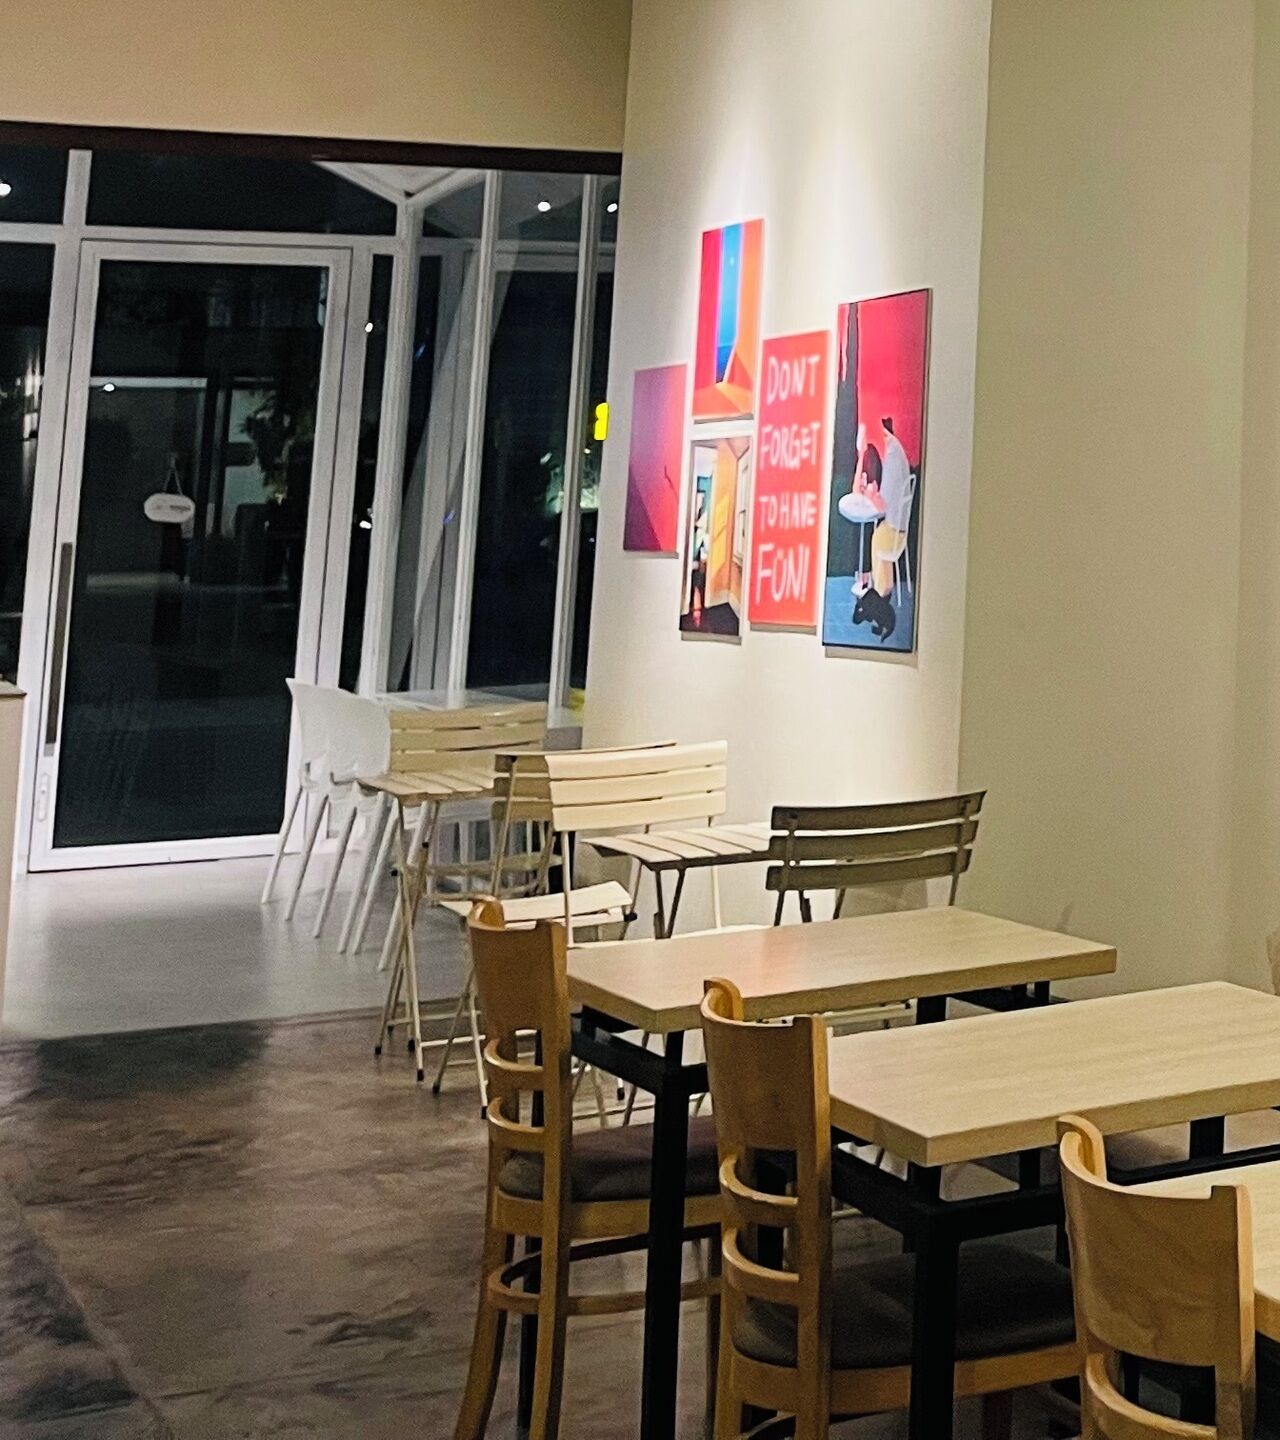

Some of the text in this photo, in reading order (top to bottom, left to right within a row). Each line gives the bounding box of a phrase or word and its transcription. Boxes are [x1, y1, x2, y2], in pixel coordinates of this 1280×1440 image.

[760, 421, 821, 471] FORGET
[758, 491, 817, 533] TO HAVE
